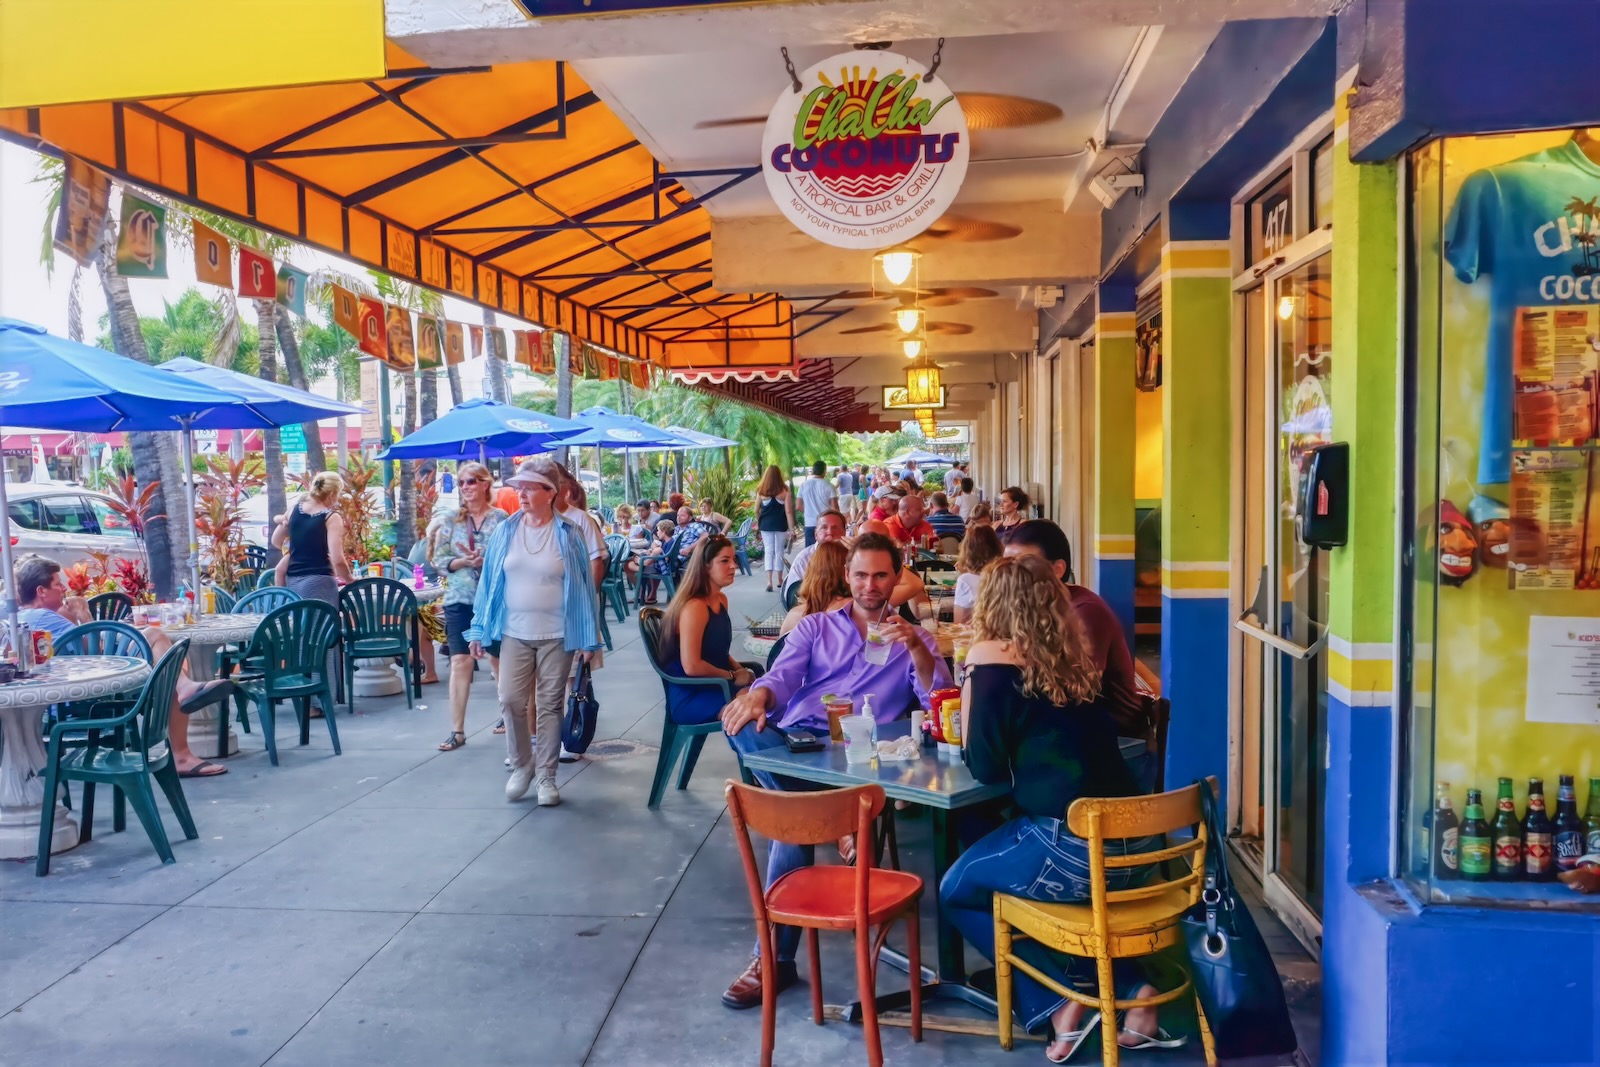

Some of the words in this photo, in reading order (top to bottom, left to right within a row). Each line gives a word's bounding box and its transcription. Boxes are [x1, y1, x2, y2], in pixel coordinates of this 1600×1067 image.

[771, 132, 960, 173] COCONUTS
[795, 175, 805, 187] A
[804, 183, 862, 217] TROPICAL
[865, 199, 893, 217] BAR
[895, 194, 907, 206] &
[906, 166, 937, 196] GRILL
[790, 197, 808, 217] NOT
[806, 212, 830, 231] YOUR
[831, 225, 869, 237] TYPICAL
[871, 214, 917, 236] TROPICAL
[1265, 199, 1288, 256] 417
